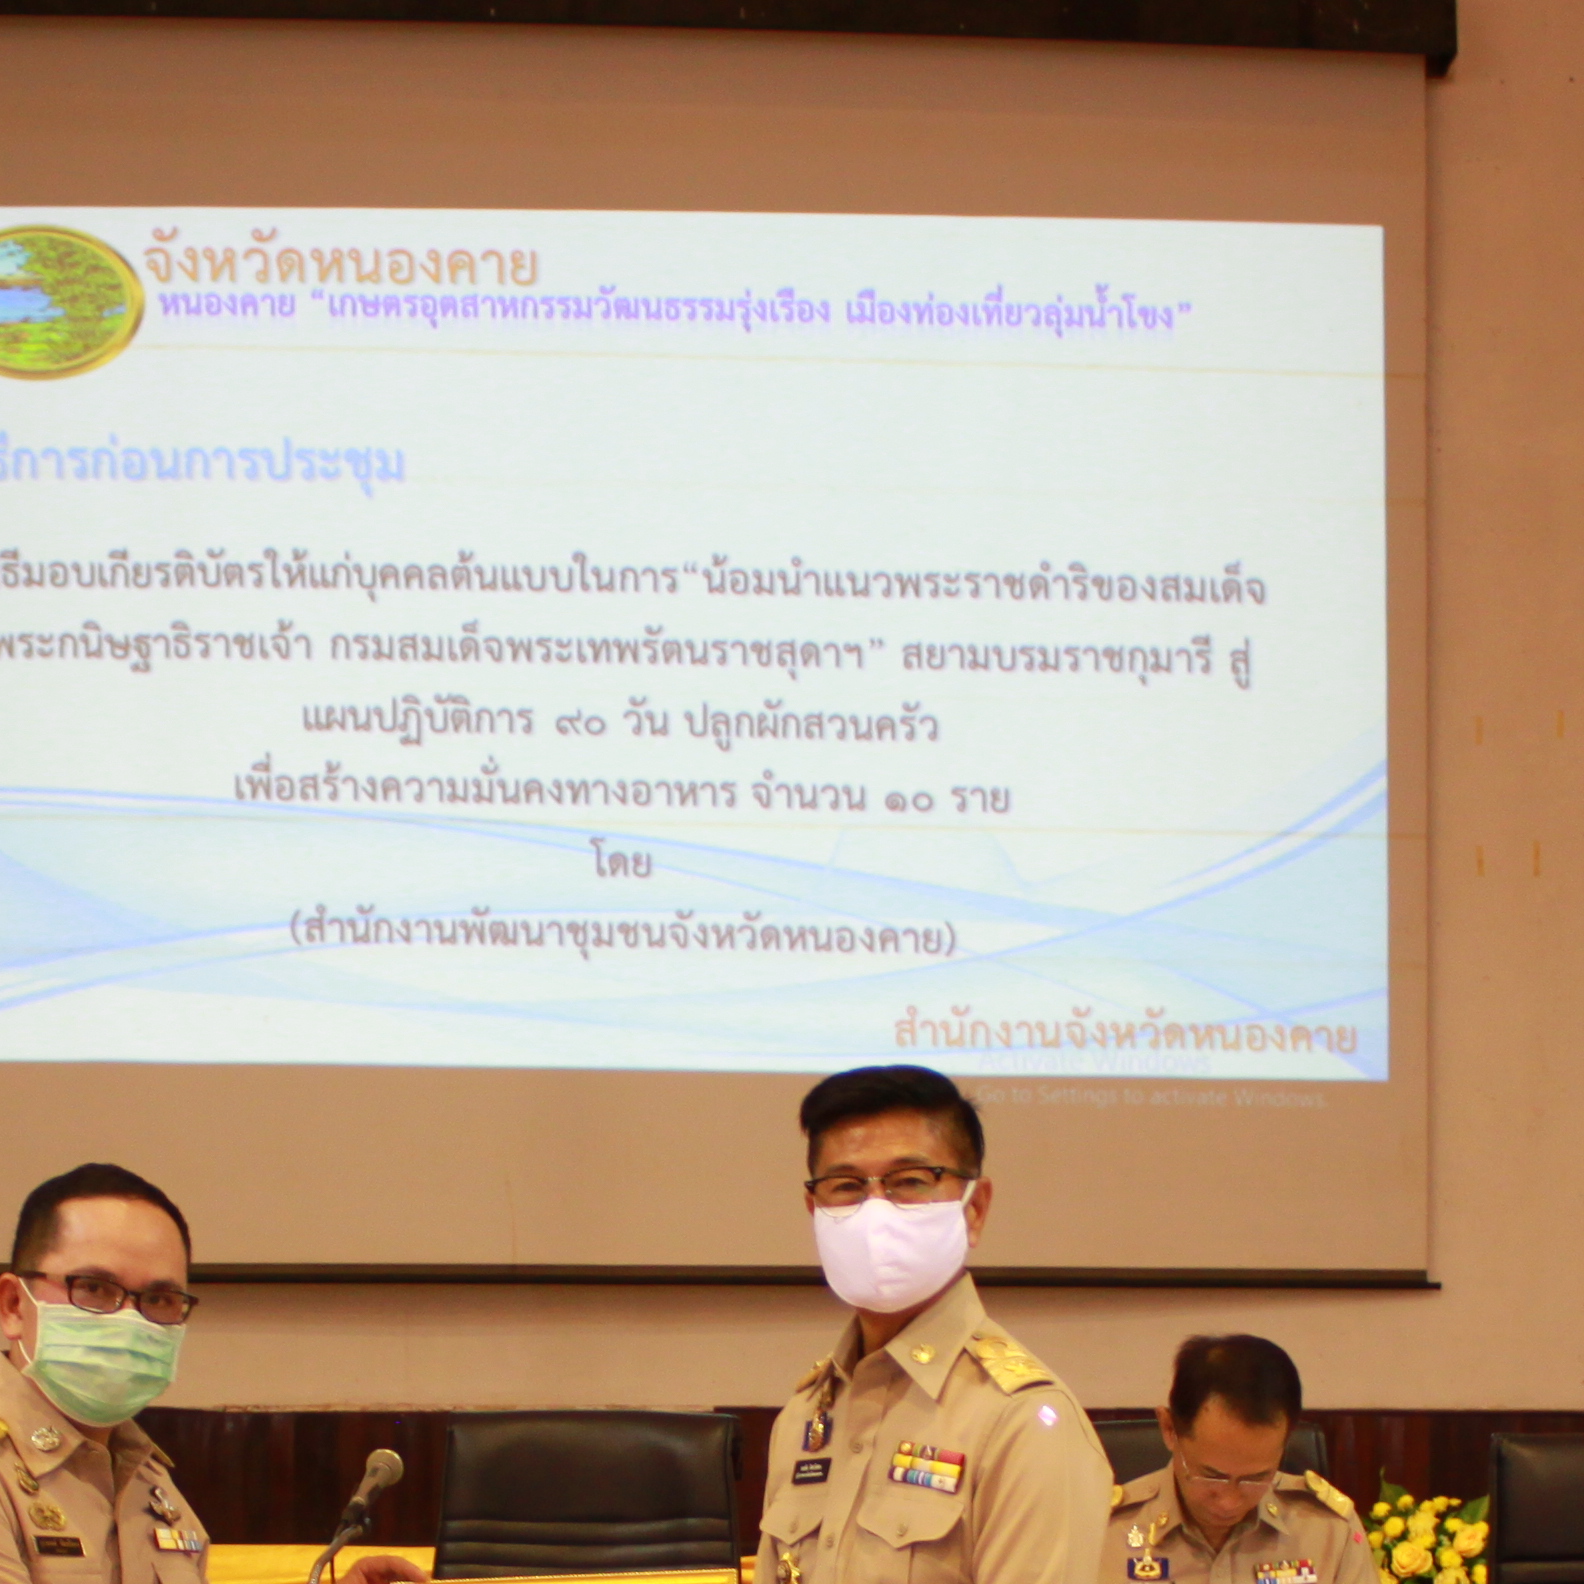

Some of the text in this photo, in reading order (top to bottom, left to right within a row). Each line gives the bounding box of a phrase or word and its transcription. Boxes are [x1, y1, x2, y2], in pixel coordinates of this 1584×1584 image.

[143, 227, 539, 287] จังหวัดหนองคาย
[158, 290, 297, 319] หนองคาย
[902, 632, 1213, 687] สยามบรมราชกุมารี
[1229, 637, 1253, 692] สู่
[302, 692, 941, 753] แผนปฏิบัติการ ๙๐ วัน ปลูกผักสวนครัว
[233, 753, 1011, 814] เพื่อสร้างความมั่นคงทางอาหาร จำนวน ๑๐ ราย
[590, 837, 654, 879] โดย
[289, 903, 957, 962] (สำนักงานพัฒนาชุมชนจังหวัดหนองคาย)
[894, 1005, 1358, 1056] สำนักงานจังหวัดหนองคาย
[978, 1053, 1212, 1075] Activate Windows
[977, 1085, 1006, 1102] Go
[1010, 1087, 1033, 1102] to
[1038, 1086, 1118, 1107] Settings
[1123, 1088, 1145, 1104] to
[1150, 1087, 1227, 1105] activate
